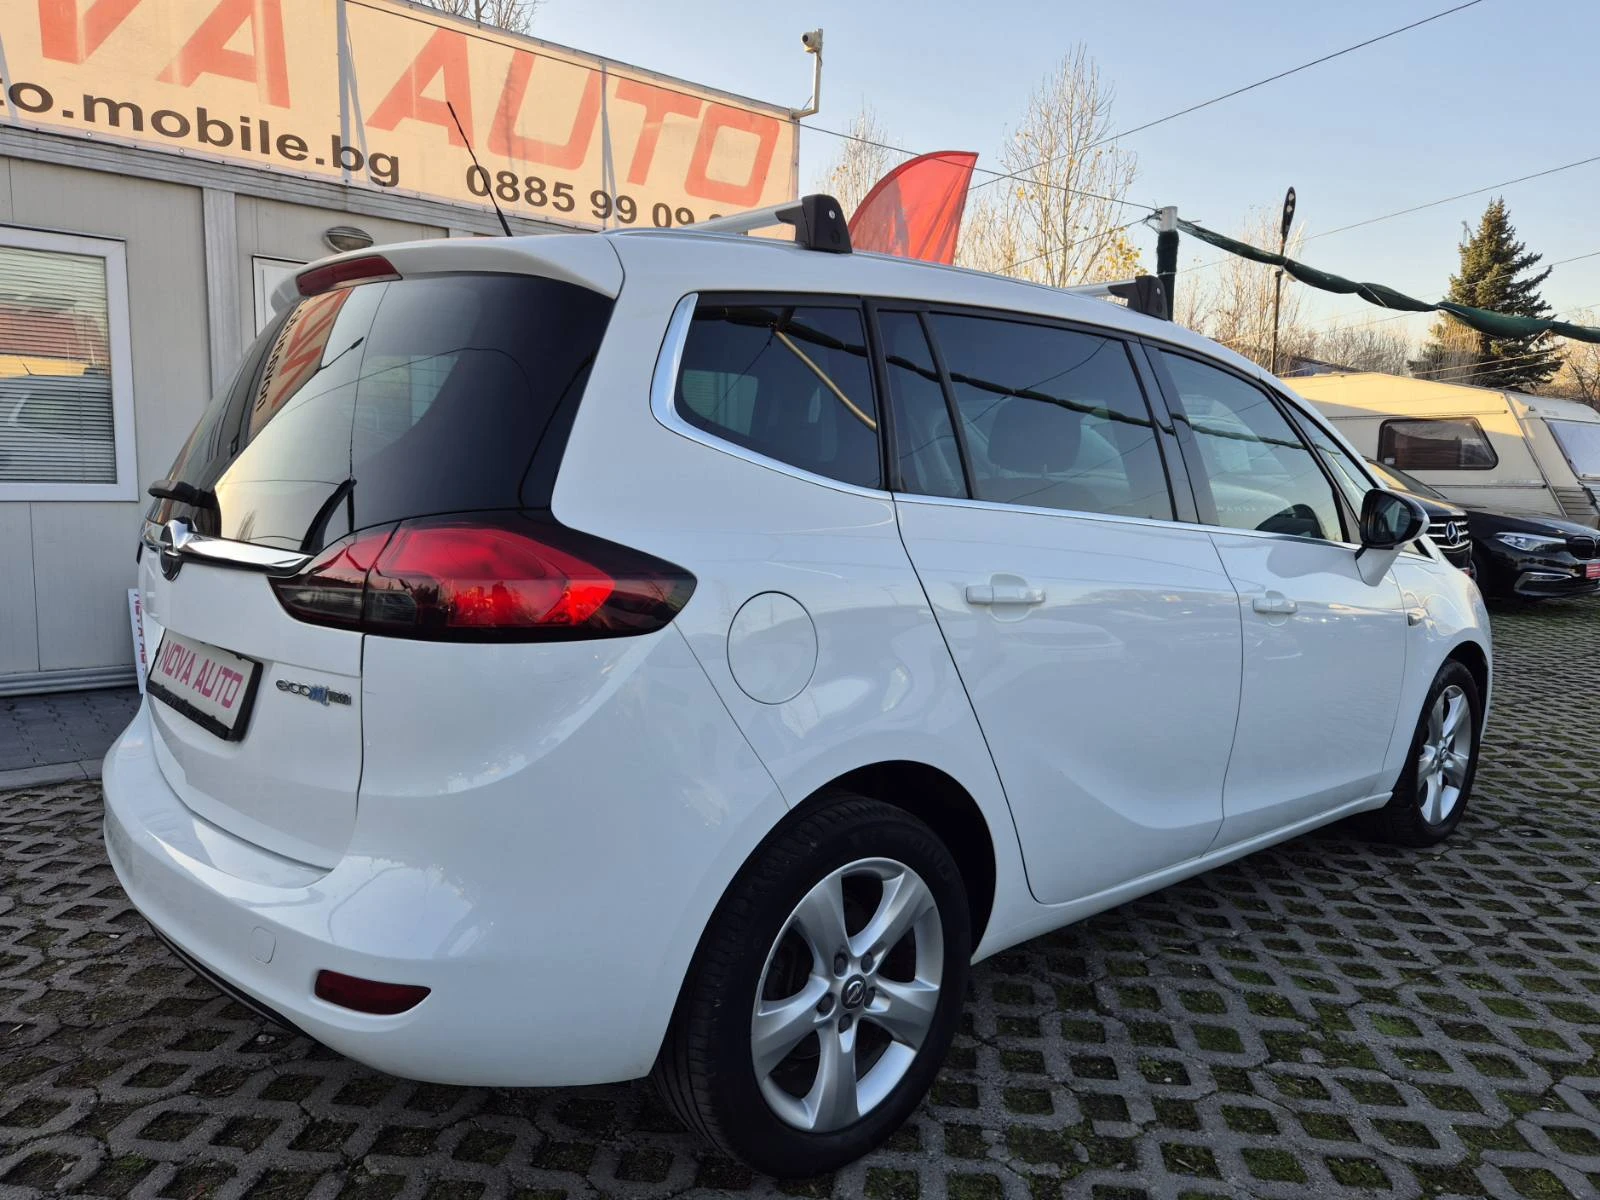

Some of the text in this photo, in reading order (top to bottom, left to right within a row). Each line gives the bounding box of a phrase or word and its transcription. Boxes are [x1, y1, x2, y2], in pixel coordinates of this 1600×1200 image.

[0, 78, 400, 188] o.mobile.bg
[365, 27, 780, 208] AUTO
[466, 164, 576, 212] 0885
[589, 190, 637, 224] 99
[158, 639, 244, 709] NOVA AUTO
